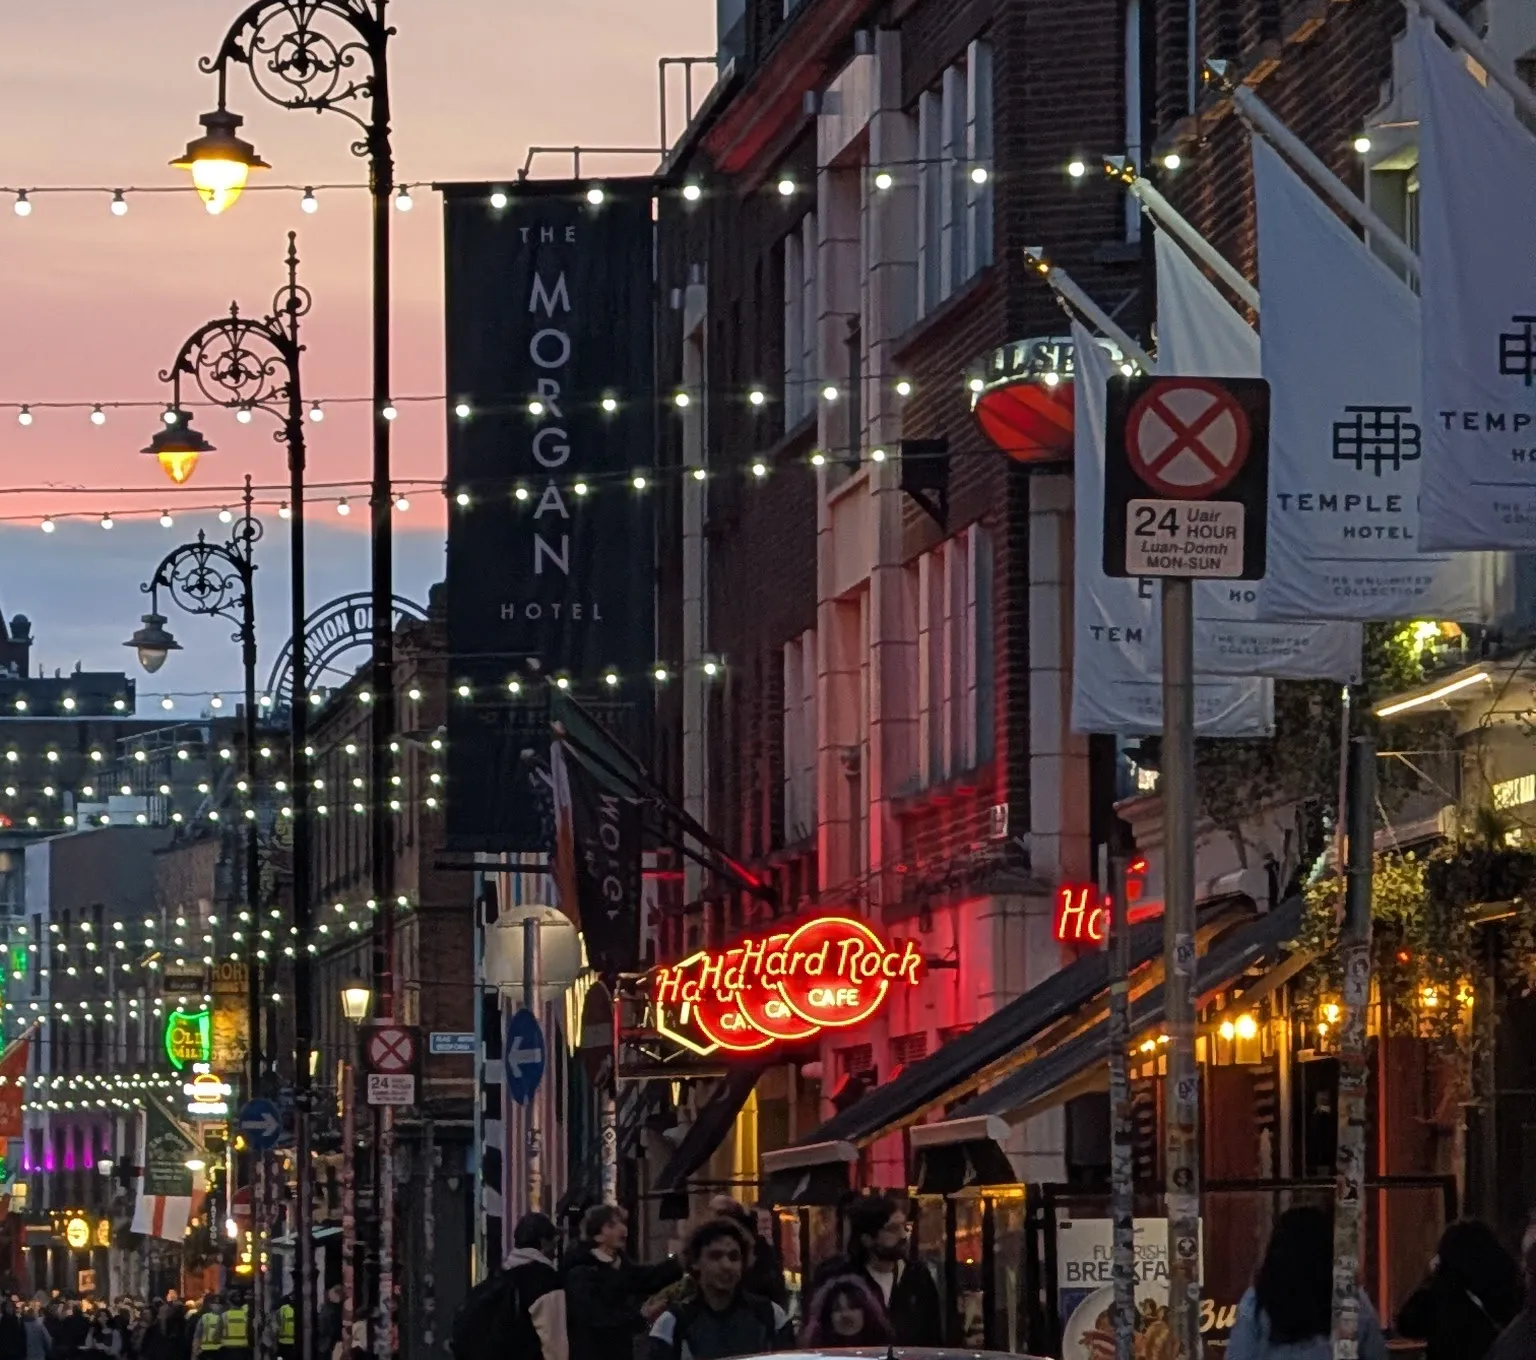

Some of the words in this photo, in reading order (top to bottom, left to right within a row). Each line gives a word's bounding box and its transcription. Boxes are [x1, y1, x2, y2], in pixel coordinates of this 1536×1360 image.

[518, 226, 577, 242] THE
[528, 271, 572, 576] MORGAN
[1440, 411, 1532, 433] TEMP
[1276, 493, 1402, 513] TEMPLE
[1134, 506, 1180, 538] 24
[1187, 508, 1222, 523] Uair
[1186, 524, 1237, 541] HOUR
[1343, 526, 1413, 540] HOTEL
[1141, 539, 1228, 555] Luan-Domh
[1147, 555, 1221, 570] MON-SUN
[500, 603, 603, 621] HOTEL
[1090, 625, 1143, 643] TEM
[740, 939, 830, 976] Hard
[837, 936, 922, 985] Rock
[807, 988, 860, 1008] CAFE
[371, 1076, 389, 1089] 24
[1133, 1244, 1167, 1260] RISH
[1066, 1261, 1170, 1282] BREKFA
